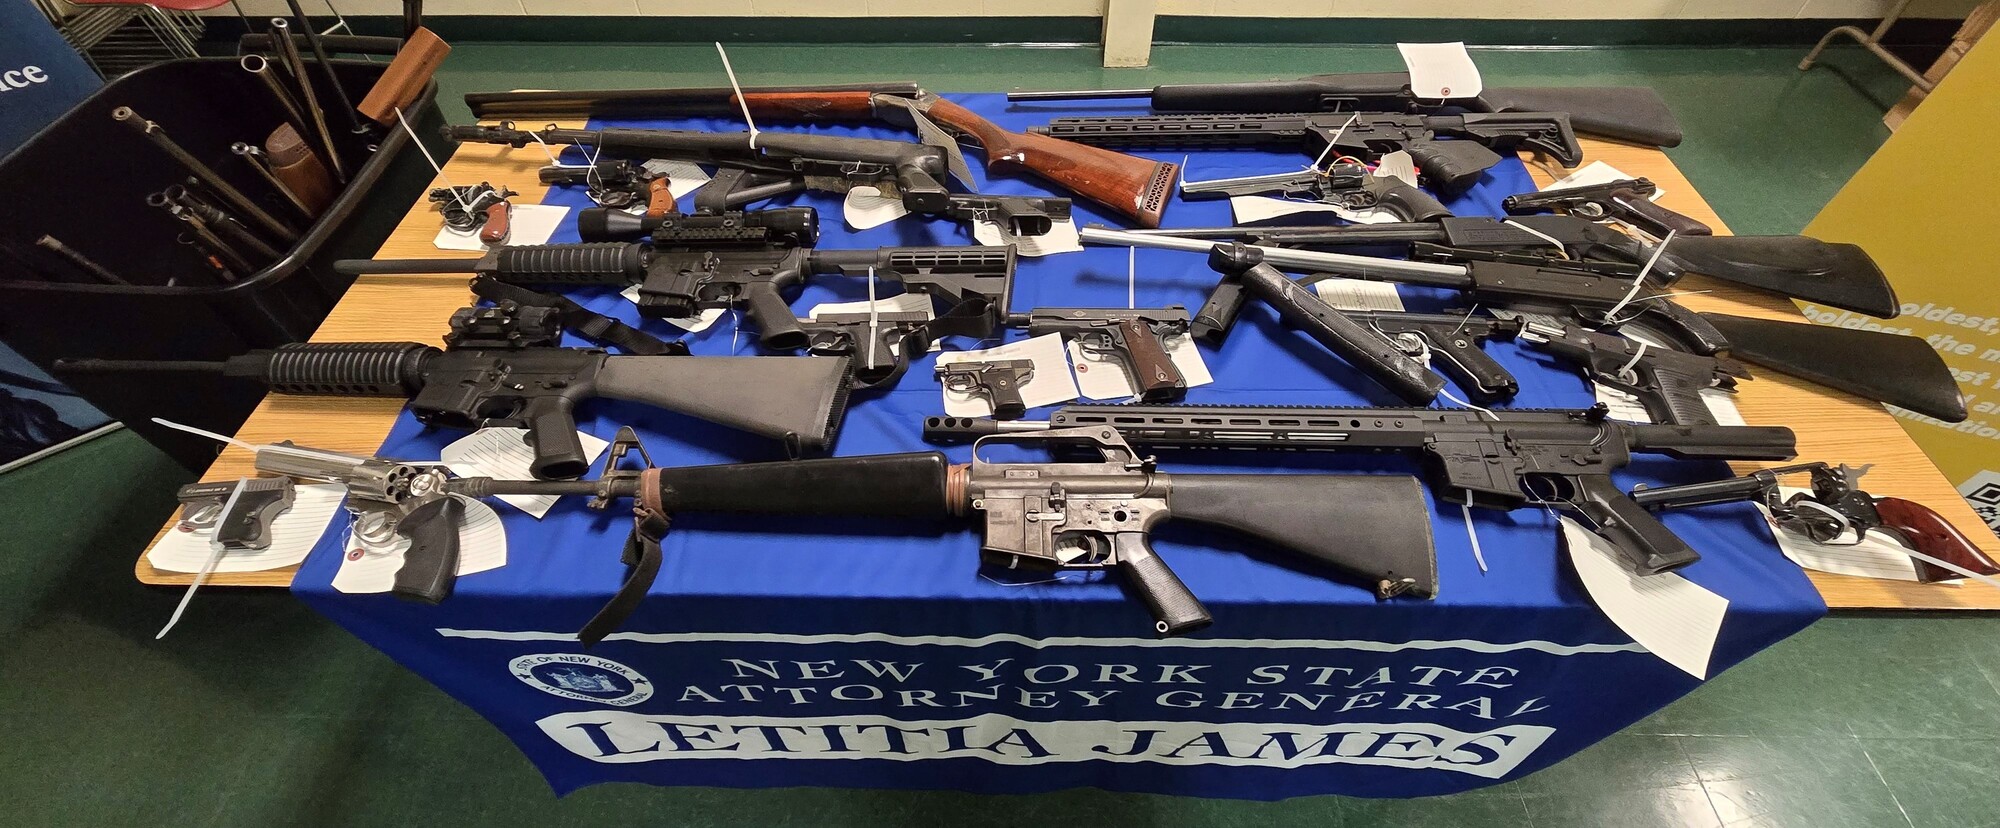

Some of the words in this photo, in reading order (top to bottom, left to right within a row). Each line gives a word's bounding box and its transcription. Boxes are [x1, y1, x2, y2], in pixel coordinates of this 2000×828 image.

[1926, 334, 1976, 355] the
[558, 656, 591, 664] NEW
[597, 660, 631, 675] YORK
[721, 657, 926, 683] NEW
[959, 657, 1213, 685] YORK
[1246, 664, 1520, 688] STATE
[680, 683, 1124, 709] ATTORNEY
[1156, 690, 1550, 719] GENERAL
[566, 720, 1065, 758] LETITIA
[1091, 726, 1519, 765] JAMES
